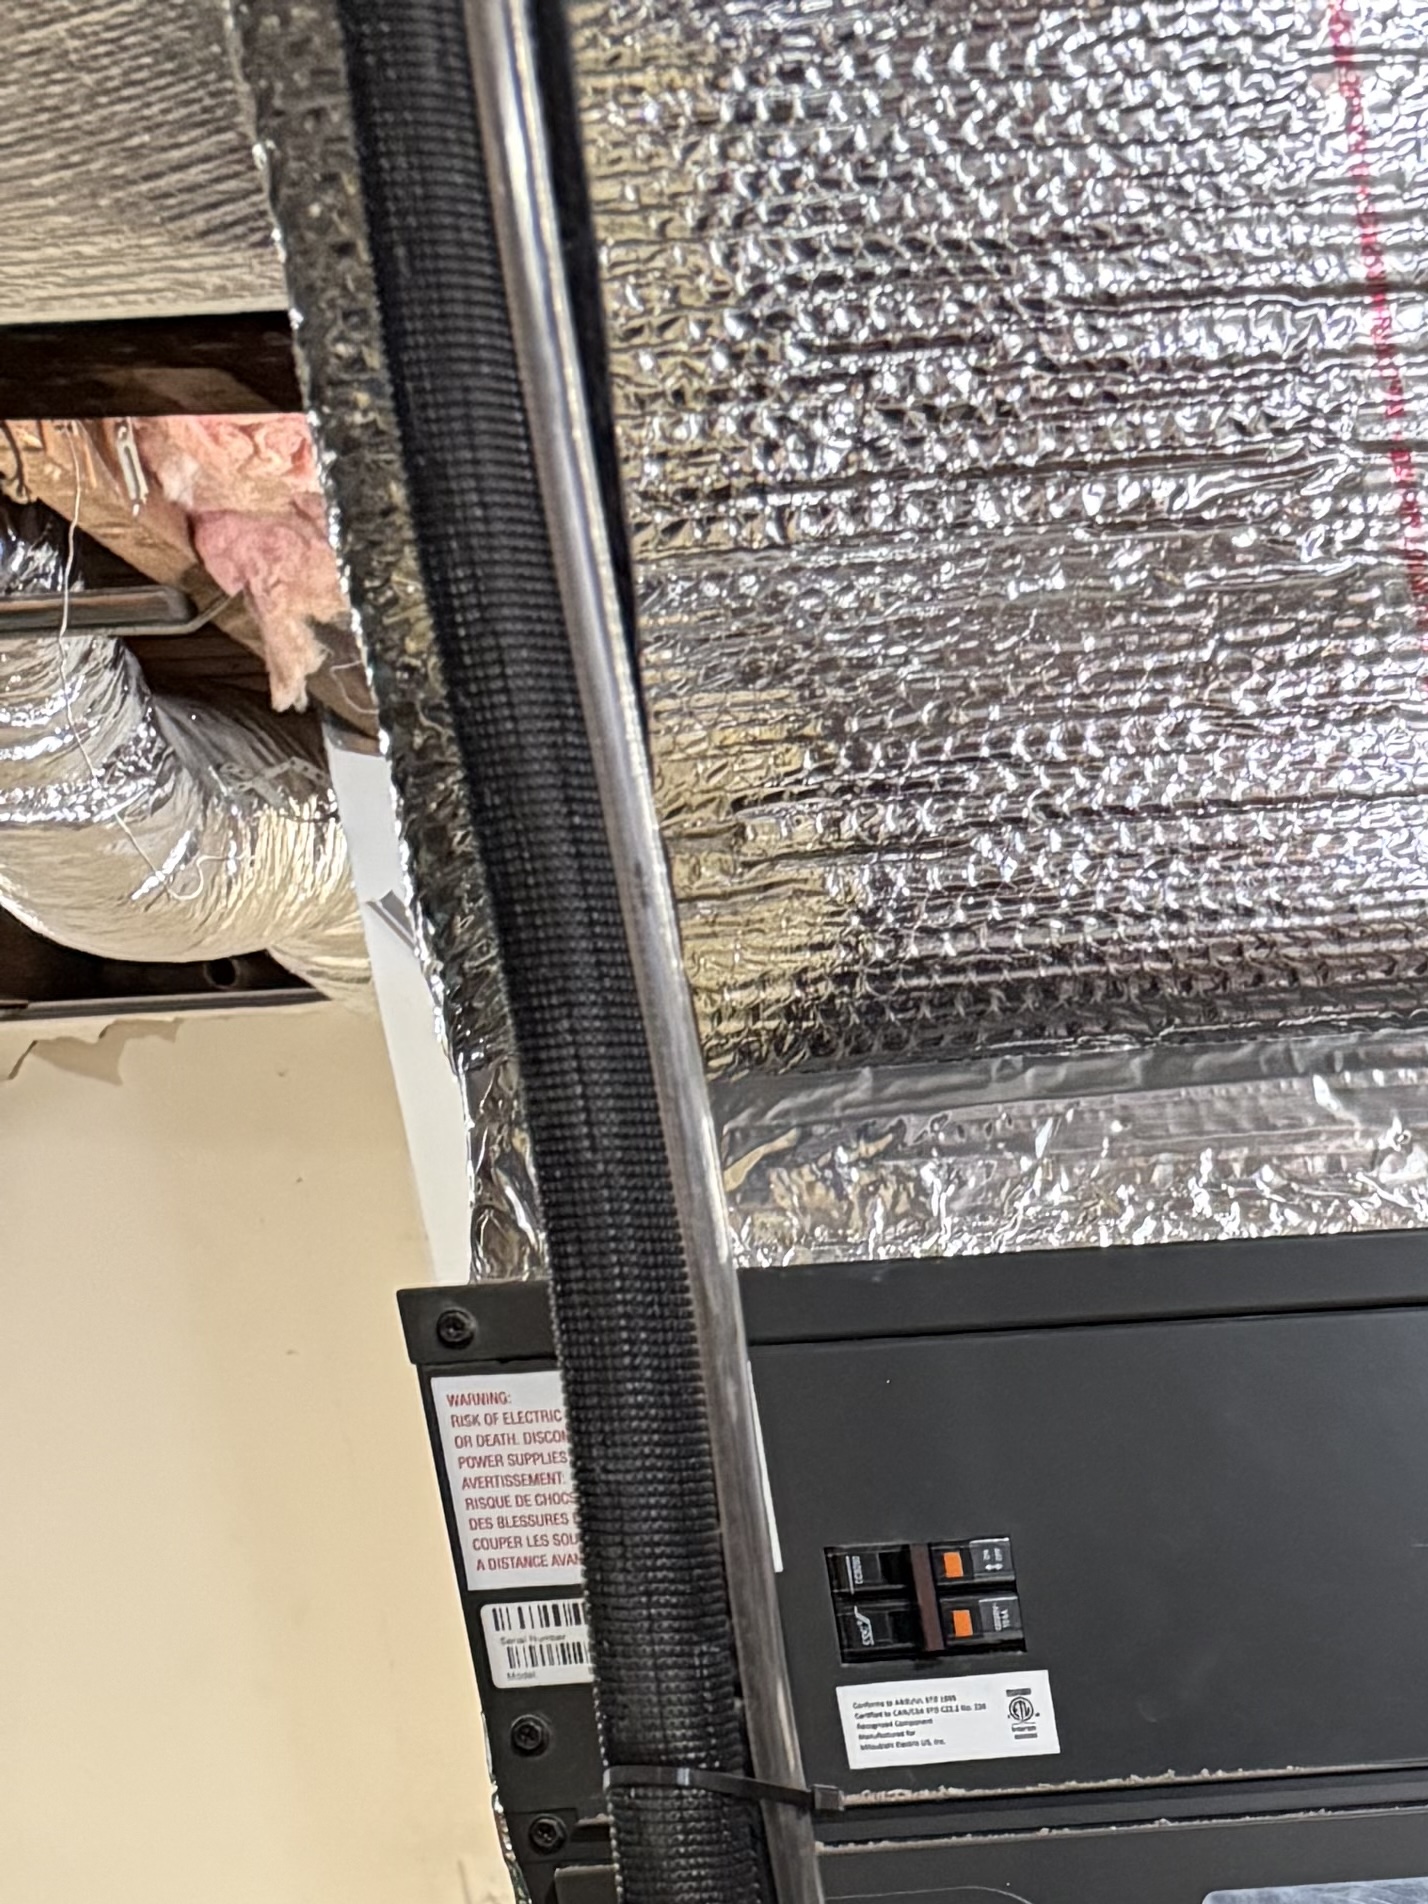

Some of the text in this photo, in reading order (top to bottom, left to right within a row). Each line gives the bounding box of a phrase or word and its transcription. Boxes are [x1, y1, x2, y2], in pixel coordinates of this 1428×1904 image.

[450, 1409, 561, 1427] RISK OF ELECTRIC
[457, 1450, 567, 1469] POWER SUPPLIES
[468, 1512, 569, 1530] DES BLESSURES
